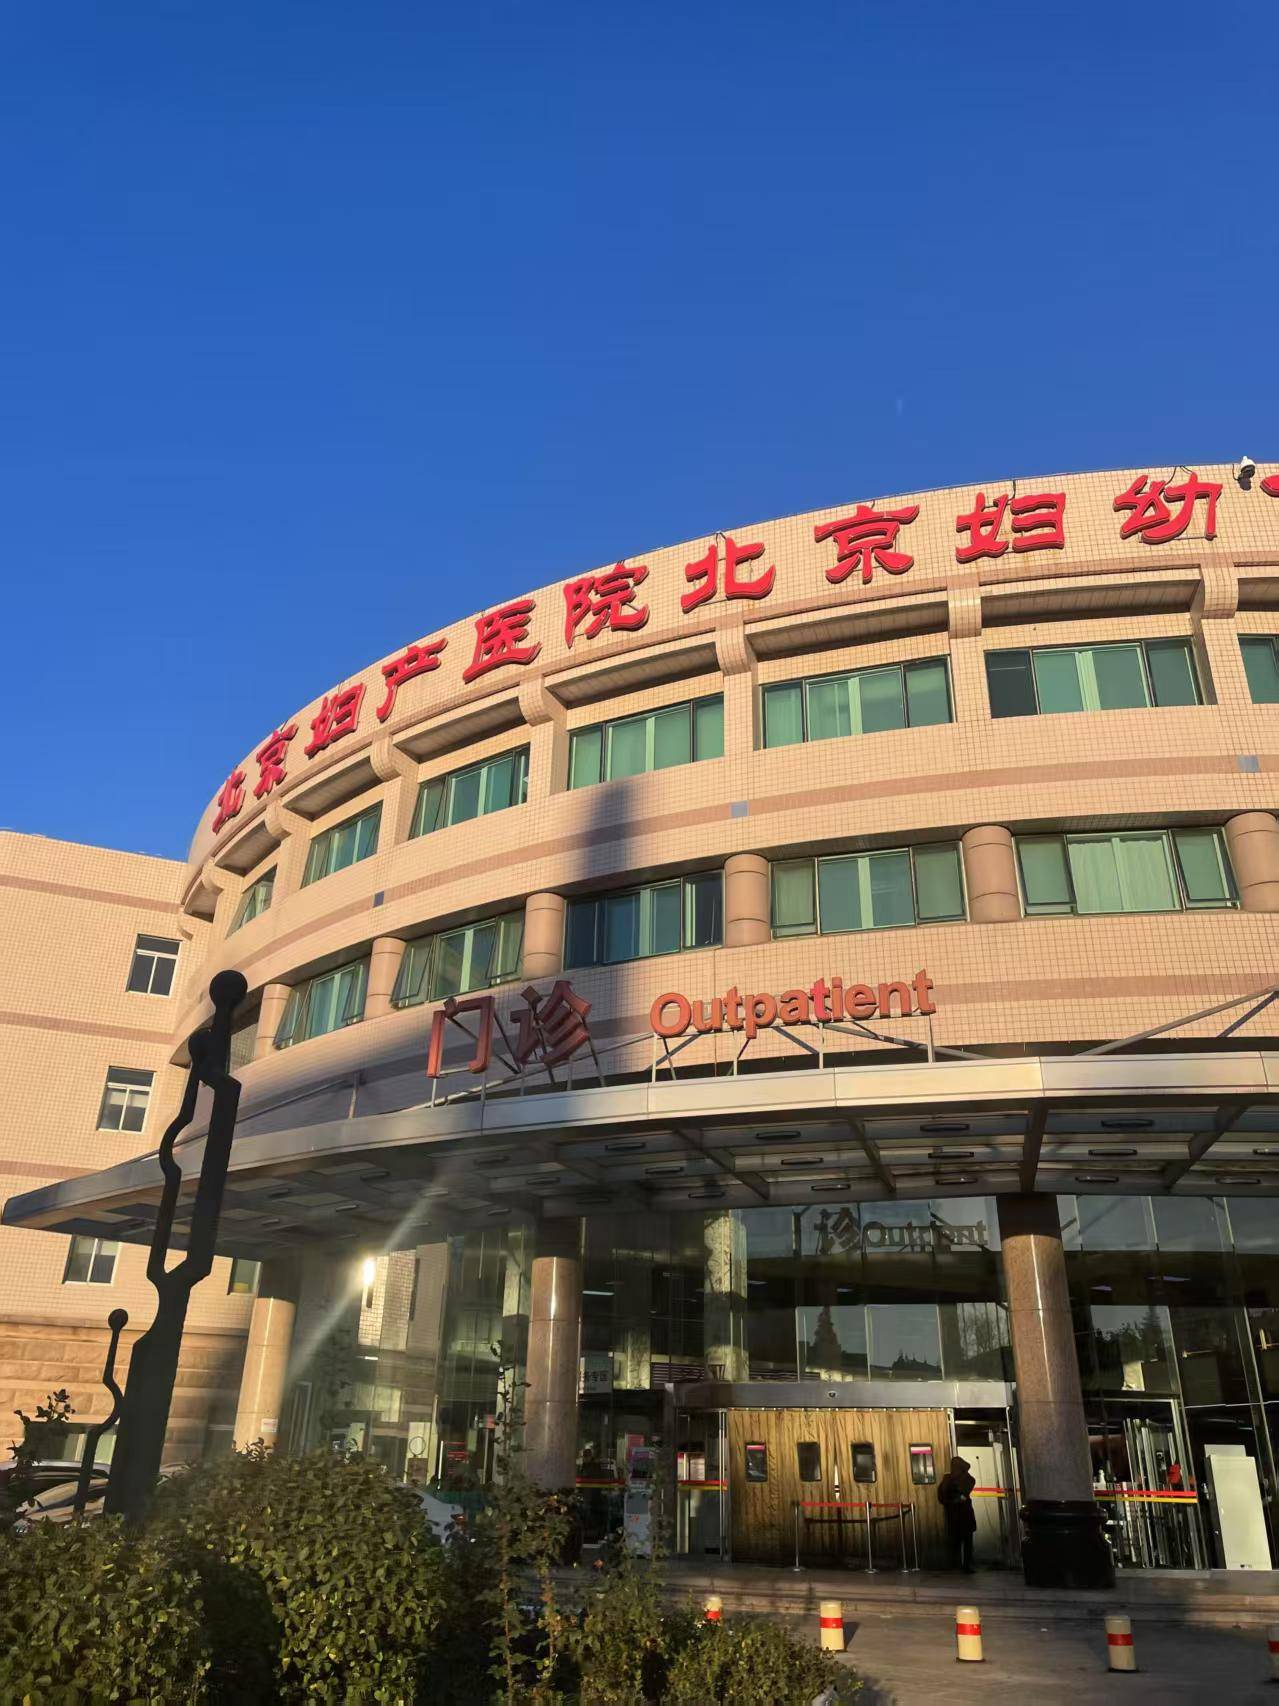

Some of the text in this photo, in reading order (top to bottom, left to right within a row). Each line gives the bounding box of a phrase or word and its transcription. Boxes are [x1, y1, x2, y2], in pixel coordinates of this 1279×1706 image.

[211, 472, 1279, 835] 北京妇产医院北京妇幼
[427, 980, 592, 1079] 门诊
[650, 969, 936, 1039] Outpatient
